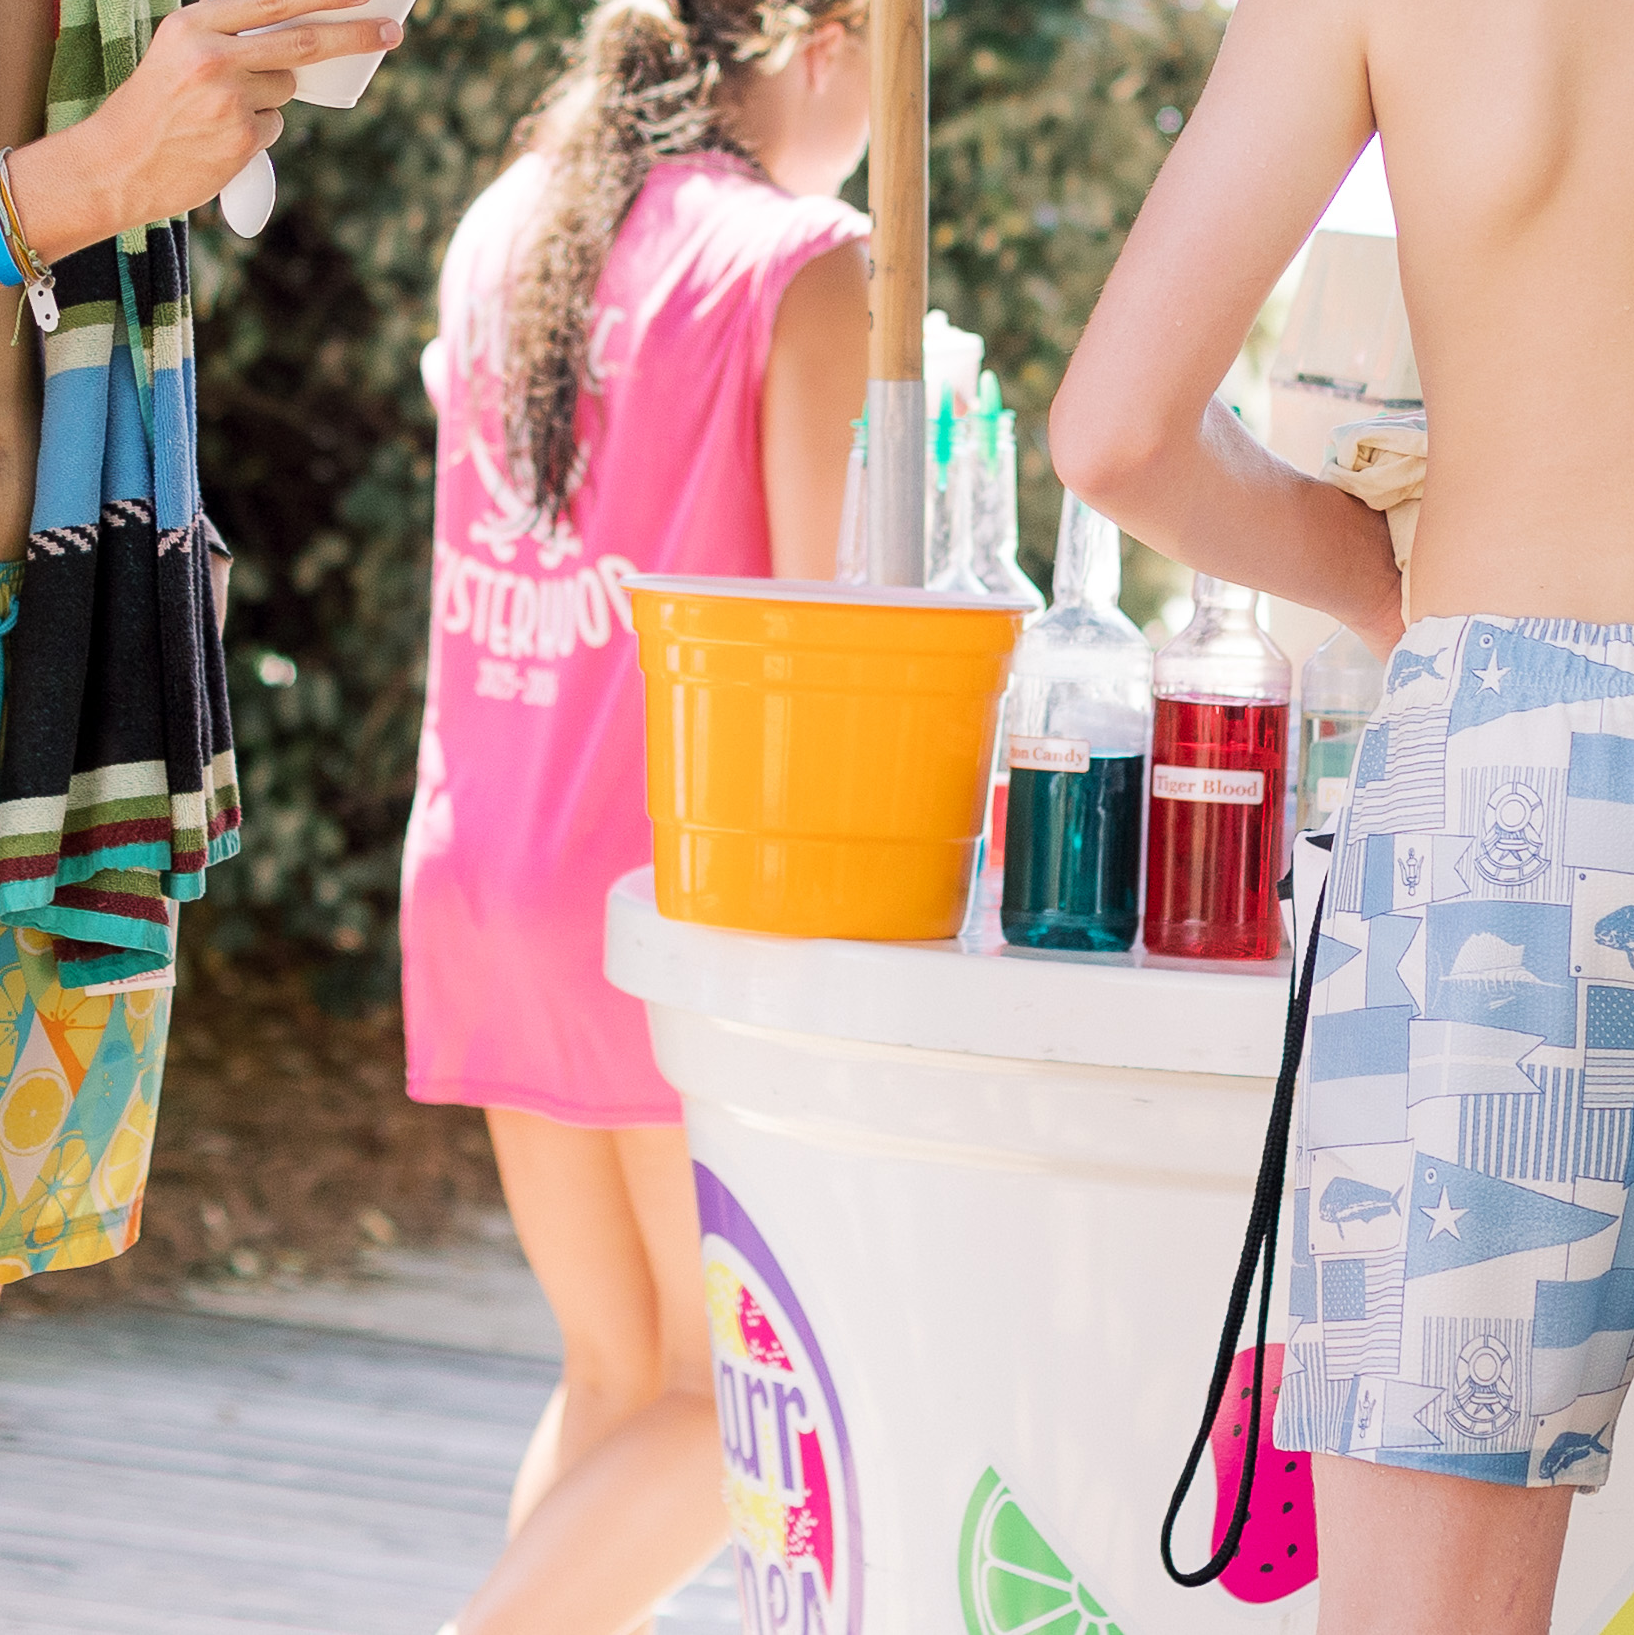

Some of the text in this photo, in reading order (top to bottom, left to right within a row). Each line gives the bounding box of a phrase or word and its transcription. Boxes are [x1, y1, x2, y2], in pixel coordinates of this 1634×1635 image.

[1032, 746, 1086, 767] Candy
[1157, 775, 1258, 798] Tiger Blood
